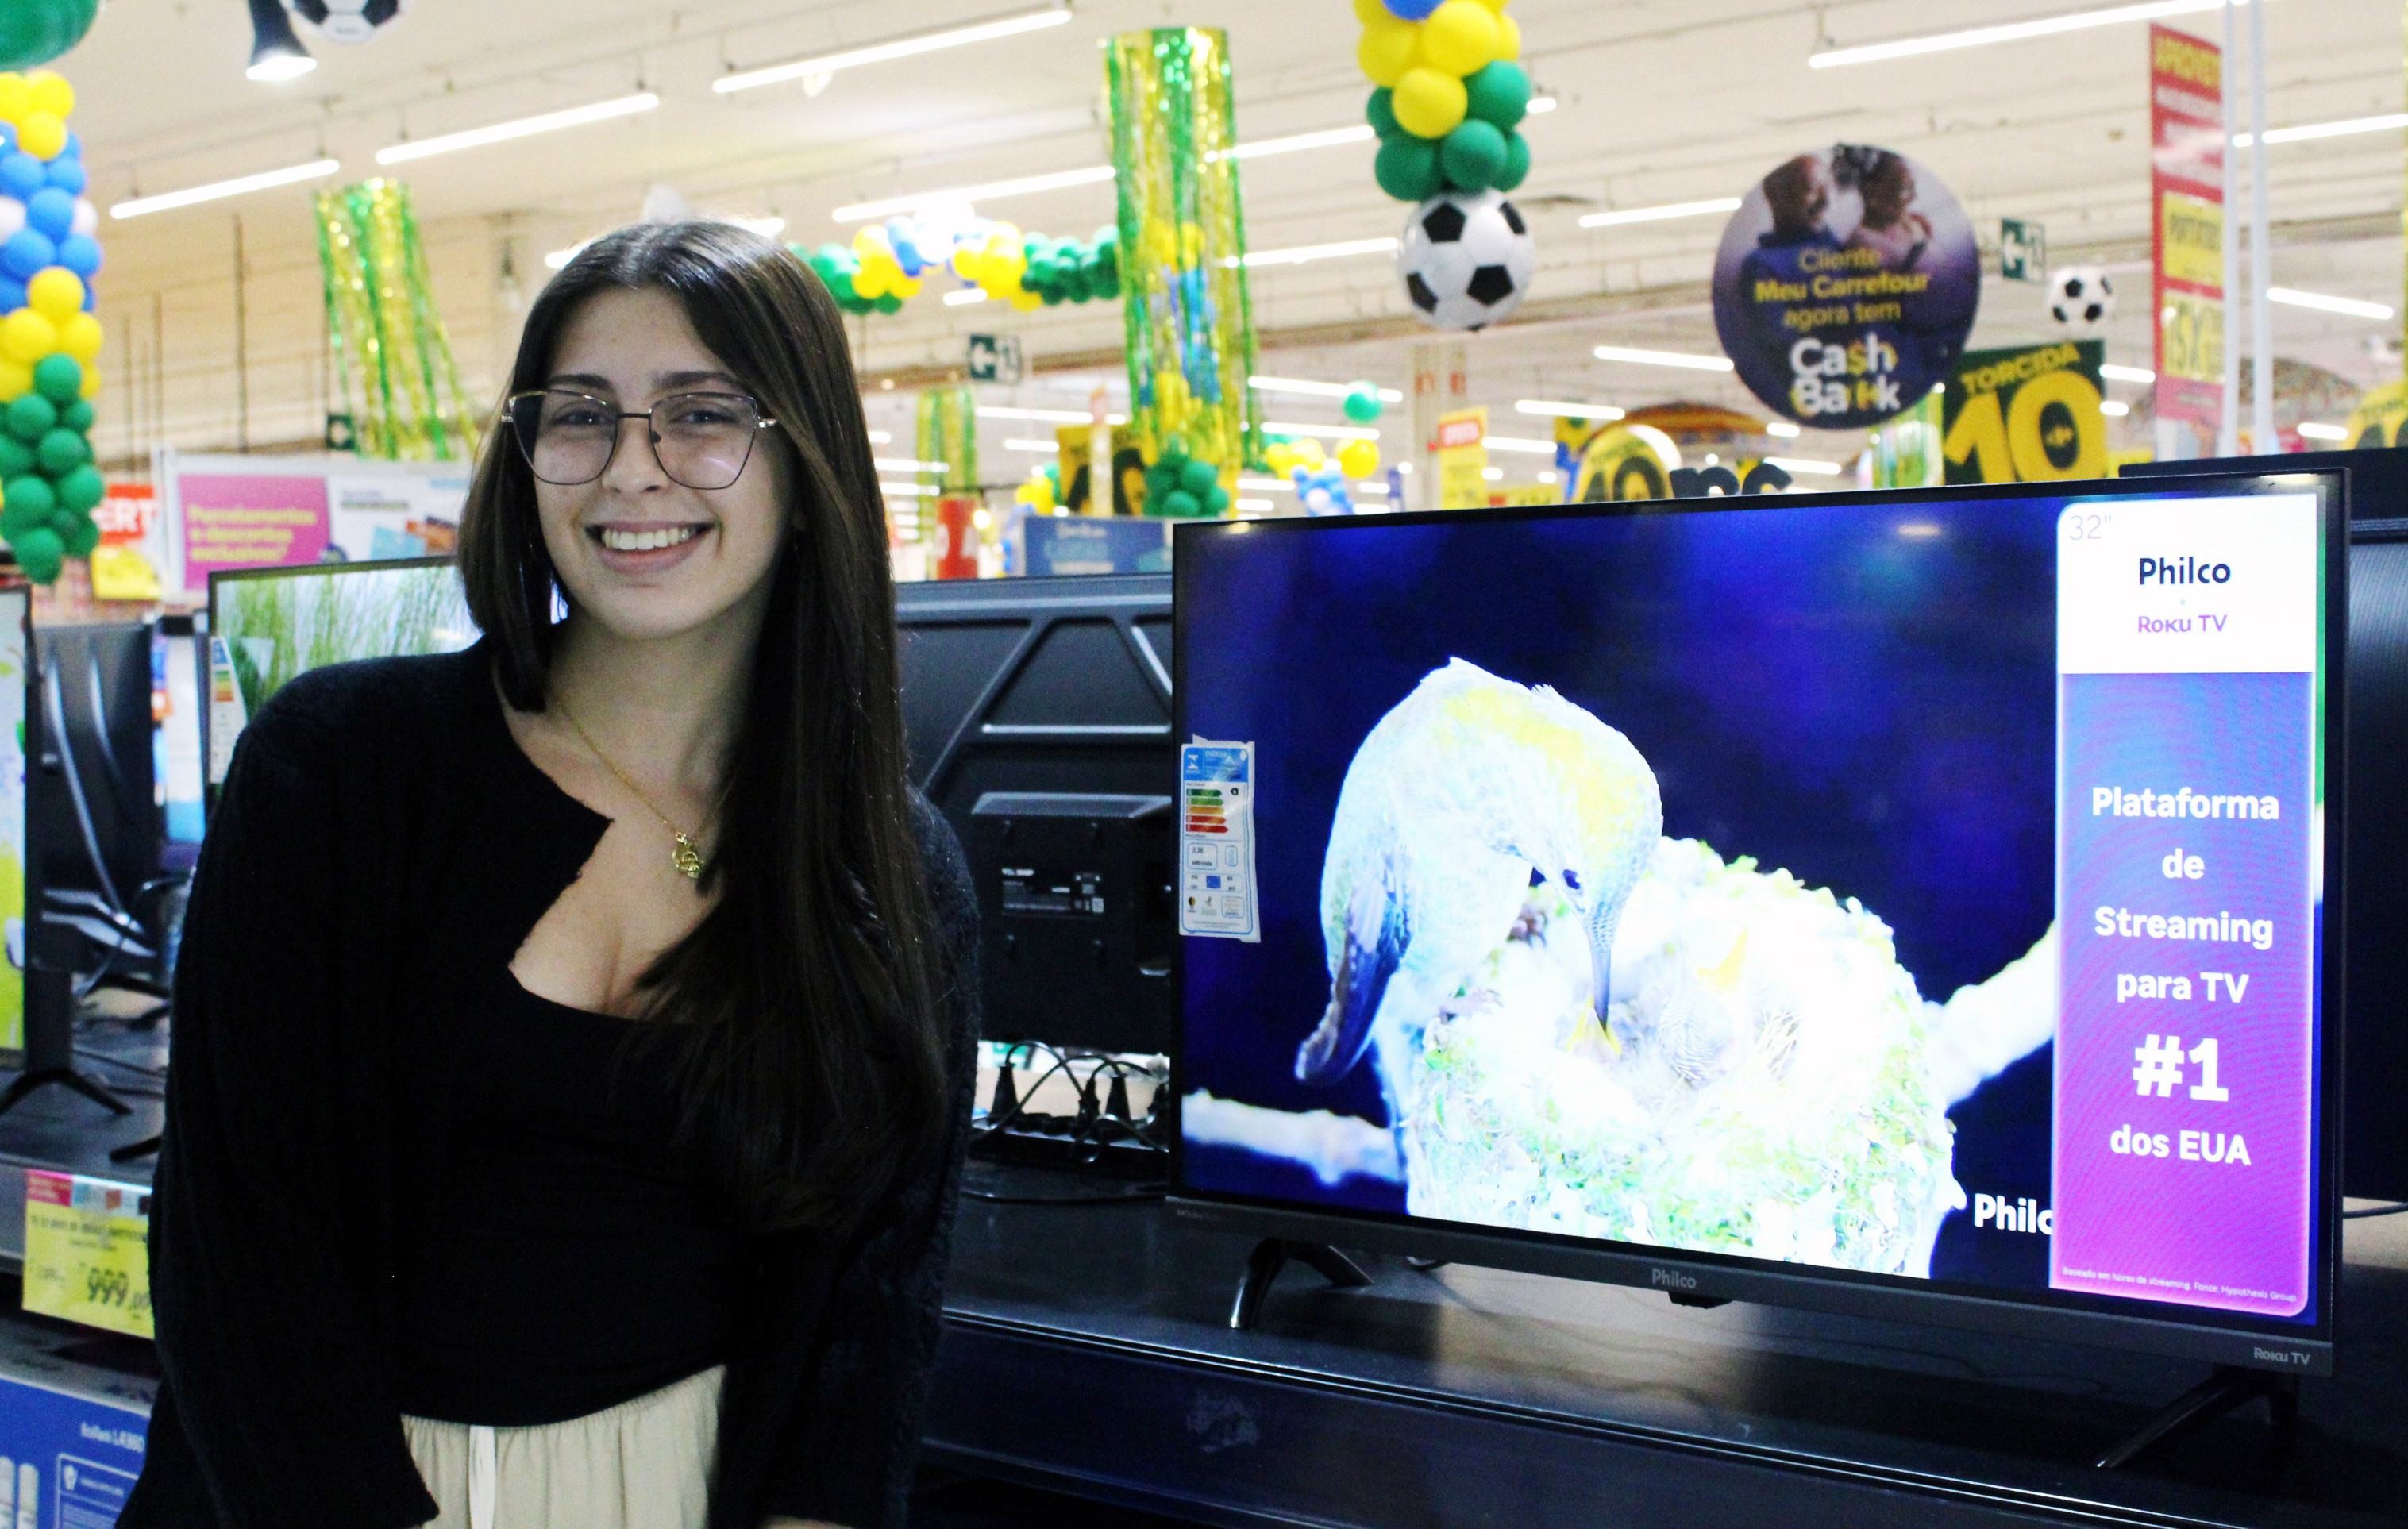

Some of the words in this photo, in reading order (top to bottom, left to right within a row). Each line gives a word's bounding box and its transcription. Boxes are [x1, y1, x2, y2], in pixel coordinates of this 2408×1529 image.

[1800, 248, 1881, 272] Cliente
[1755, 279, 1807, 302] Meu
[1813, 272, 1929, 298] Carrefour
[1784, 306, 1849, 332] agora
[1855, 302, 1901, 322] tem
[1790, 333, 1898, 377] Cash
[1961, 342, 2081, 395] TORCIDA
[1944, 370, 2106, 484] 10
[2069, 514, 2112, 541] 32"
[2139, 557, 2231, 585] Philco
[2137, 615, 2192, 634] Roku
[2198, 614, 2228, 632] TV
[2092, 787, 2279, 820] Plataforma
[2162, 848, 2206, 880] de
[2094, 906, 2273, 950] Streaming
[2117, 973, 2192, 1003] para
[2200, 972, 2249, 1003] TV
[2133, 1034, 2229, 1102] #1
[2110, 1124, 2170, 1157] dos
[2179, 1130, 2252, 1165] EUA
[1974, 1193, 2053, 1235] Philc
[1651, 1268, 1697, 1289] Philco
[2063, 1266, 2097, 1278] Baseado
[2112, 1273, 2136, 1283] horas
[2136, 1275, 2147, 1284] de
[2253, 1347, 2289, 1363] Roku
[2291, 1351, 2311, 1366] TV
